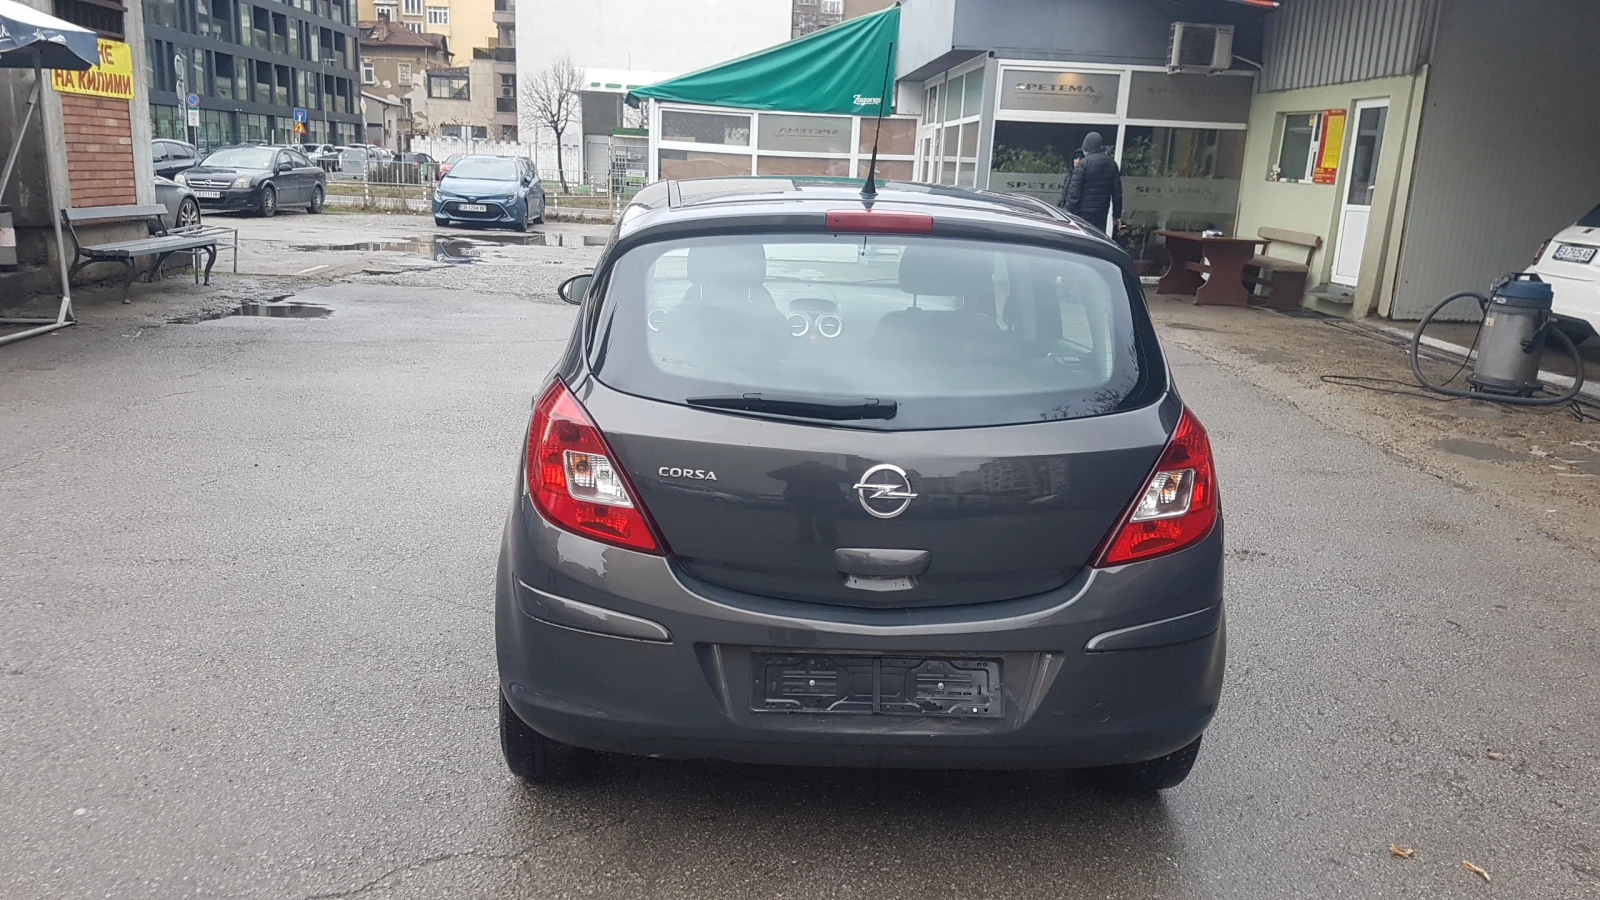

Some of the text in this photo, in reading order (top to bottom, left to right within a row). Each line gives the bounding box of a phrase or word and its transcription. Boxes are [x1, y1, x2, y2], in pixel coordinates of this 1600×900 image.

[55, 69, 132, 95] НА КИЛИМИ
[1016, 83, 1095, 92] SPETEMA
[1006, 181, 1064, 190] SPETE
[658, 466, 718, 481] CORSA
